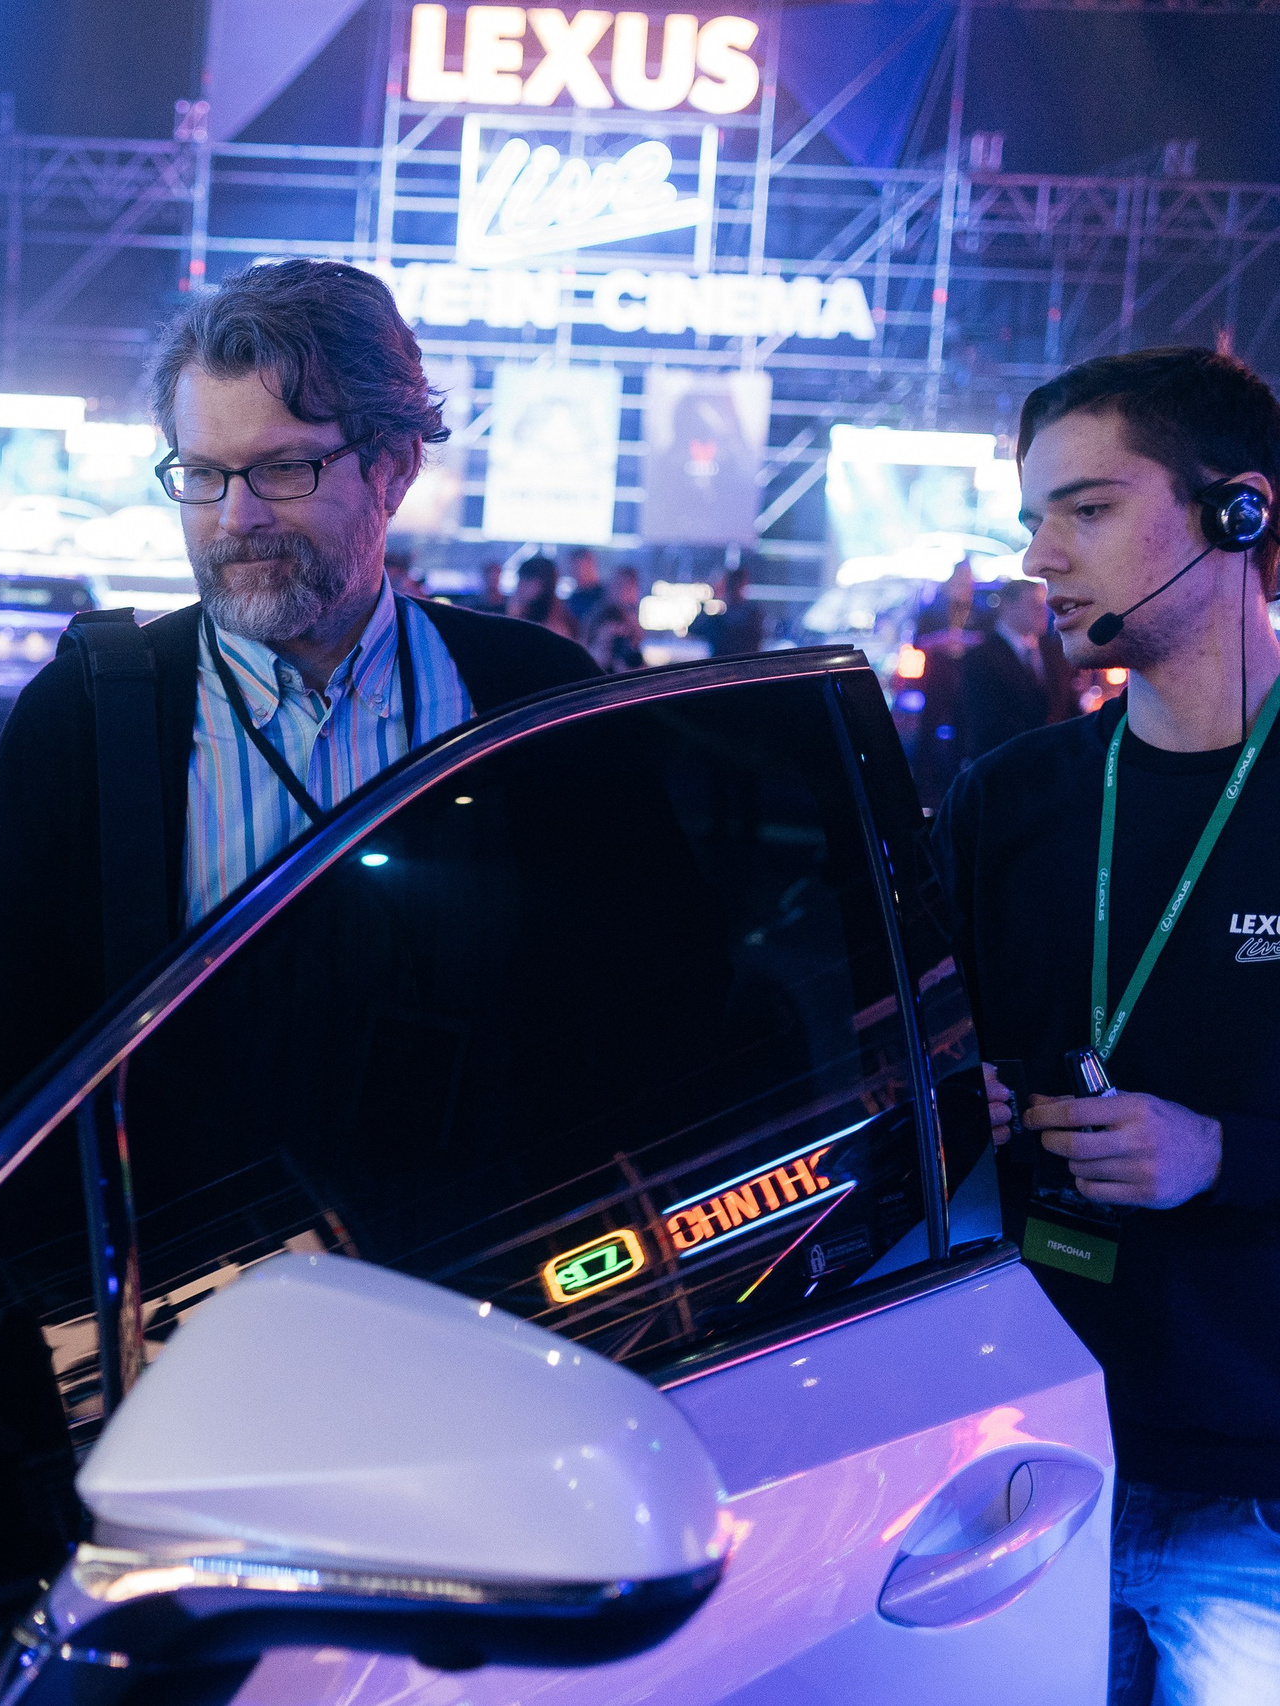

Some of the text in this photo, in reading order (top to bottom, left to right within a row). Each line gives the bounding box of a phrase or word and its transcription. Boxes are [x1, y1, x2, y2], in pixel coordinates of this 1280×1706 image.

[406, 3, 760, 114] LEXUS
[593, 267, 877, 340] CINEMA
[1234, 746, 1256, 786] LEXUS
[1098, 882, 1106, 922] LEXUS
[1168, 880, 1191, 918] LEXUS
[1105, 1011, 1126, 1049] LEXUS
[1047, 1240, 1092, 1260] ПЕРСОНАЛ
